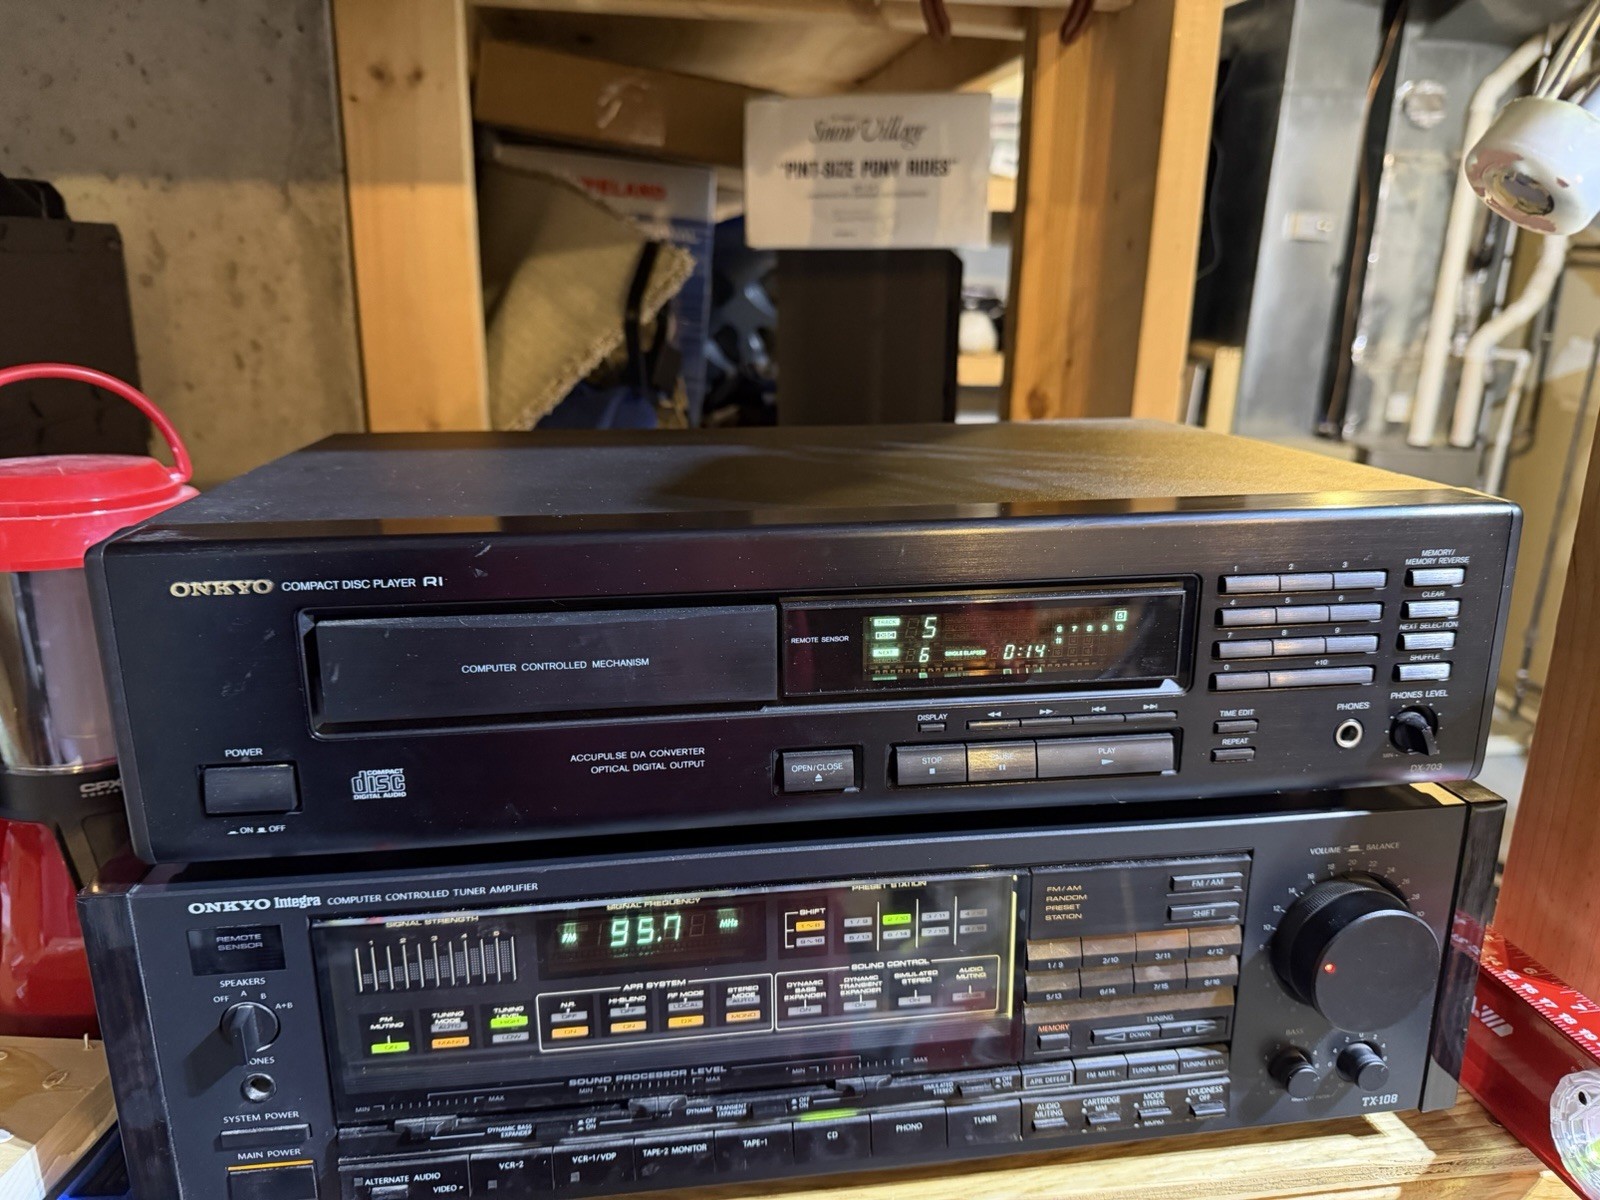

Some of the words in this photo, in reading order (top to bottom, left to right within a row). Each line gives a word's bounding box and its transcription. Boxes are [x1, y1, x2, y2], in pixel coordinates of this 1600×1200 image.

[1421, 549, 1456, 557] MEMORY/
[1405, 557, 1437, 566] MEMORY
[1438, 556, 1470, 564] REVERSE
[170, 579, 274, 597] ONKYO
[281, 581, 339, 592] COMPACT
[342, 580, 371, 589] DISC
[373, 578, 416, 588] PLAYER
[1422, 590, 1445, 598] CLEAR
[922, 616, 937, 639] 5
[1419, 620, 1458, 629] SELECTION
[790, 636, 819, 644] REMOTE
[919, 647, 930, 663] 6
[1002, 644, 1046, 660] 0:14
[1409, 653, 1440, 661] SHUFFLE
[462, 662, 517, 674] COMPUTER
[521, 660, 587, 671] CONTROLLED
[592, 657, 650, 669] MECHANISM
[1390, 691, 1422, 699] PHONES
[1337, 702, 1369, 710] PHONES
[917, 713, 947, 722] DISPLAY
[1222, 737, 1249, 745] REPEAT
[225, 748, 263, 757] POWER
[570, 750, 628, 763] ACCUPULSE
[630, 749, 647, 759] D/A
[649, 746, 705, 758] CONVERTER
[1098, 747, 1116, 755] PLAY
[922, 756, 942, 765] STOP
[367, 768, 404, 776] COMPACT
[590, 763, 629, 775] OPTICAL
[633, 761, 667, 772] DIGITAL
[669, 760, 705, 770] OUTPUT
[791, 762, 844, 773] OPEN/CLOSE
[269, 825, 286, 833] OFF
[1310, 847, 1341, 855] VOLUME
[188, 898, 271, 915] ONKYO
[274, 895, 321, 909] Integra
[327, 894, 382, 905] COMPUTER
[385, 889, 449, 901] CONTROLLED
[454, 887, 487, 897] TUNER
[490, 883, 538, 895] AMPLIFIER
[1192, 909, 1216, 918] SHIFT
[385, 920, 422, 928] SIGNAL
[424, 916, 479, 926] STRENGTH
[610, 913, 682, 947] 95.7
[216, 933, 262, 943] REMOTE
[217, 941, 264, 951] SENSOR
[851, 962, 885, 971] SOUND
[887, 959, 929, 968] CONTROL
[844, 975, 879, 983] DYNAMIC
[894, 970, 938, 979] SIMULATED
[956, 972, 987, 980] MUTING
[219, 978, 265, 988] SPEAKERS
[623, 982, 643, 990] APR
[646, 979, 686, 989] SYSTEM
[786, 980, 824, 988] DYNAMIC
[839, 981, 883, 989] TRANSIENT
[727, 985, 758, 993] STEREO
[840, 988, 882, 996] EXPANDER
[680, 990, 704, 998] MODE
[784, 992, 826, 1001] EXPANDER
[213, 995, 229, 1003] OFF
[275, 1002, 293, 1010] A+B
[370, 1022, 404, 1030] MUTING
[1038, 1024, 1070, 1032] MEMORY
[1183, 1060, 1206, 1068] TUNING
[1132, 1066, 1156, 1074] TUNING
[569, 1077, 612, 1086] SOUND
[615, 1069, 687, 1083] PROCESSOR
[691, 1067, 727, 1075] LEVEL
[1188, 1086, 1223, 1095] LOUDNESS
[1083, 1096, 1120, 1106] CARTRIDGE
[1362, 1094, 1398, 1107] TX-108
[223, 1113, 261, 1123] SYSTEM
[264, 1111, 299, 1120] POWER
[973, 1114, 997, 1124] TUNER
[895, 1122, 923, 1132] PHONO
[826, 1131, 838, 1139] CD
[743, 1138, 769, 1148] TAPE-1
[238, 1150, 264, 1160] MAIN
[267, 1148, 301, 1158] POWER
[642, 1147, 669, 1156] TAPE-2
[671, 1143, 707, 1153] MONITOR
[572, 1152, 617, 1163] VCR-1/VDP
[499, 1160, 524, 1170] VCR-2
[364, 1174, 410, 1185] ALTERNATE
[413, 1171, 441, 1181] AUDIO
[433, 1184, 457, 1193] VIDEO
